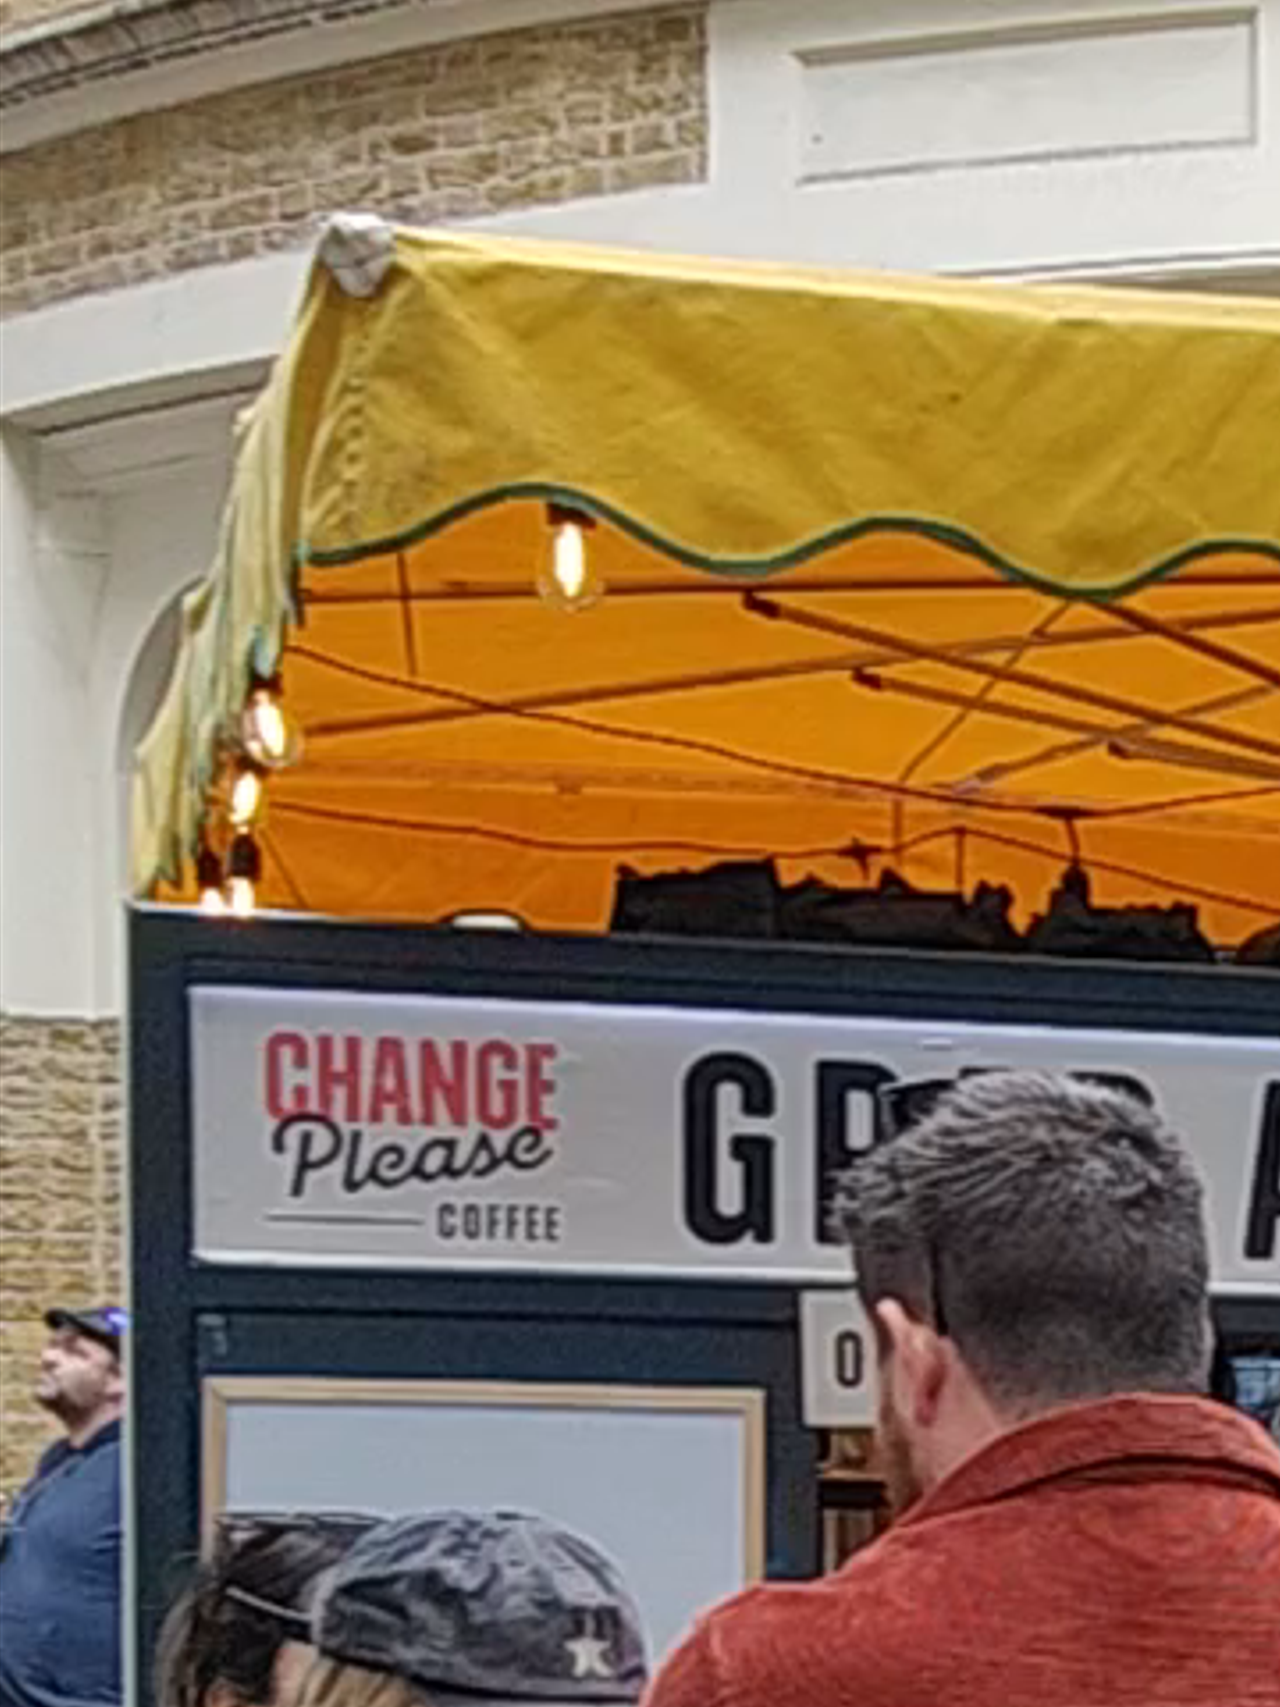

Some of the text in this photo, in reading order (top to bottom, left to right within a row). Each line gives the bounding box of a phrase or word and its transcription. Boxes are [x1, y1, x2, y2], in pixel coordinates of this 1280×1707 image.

[265, 1031, 559, 1130] CHANGE
[272, 1113, 553, 1198] Please
[682, 1050, 1156, 1245] GR
[437, 1202, 560, 1242] COFFEE
